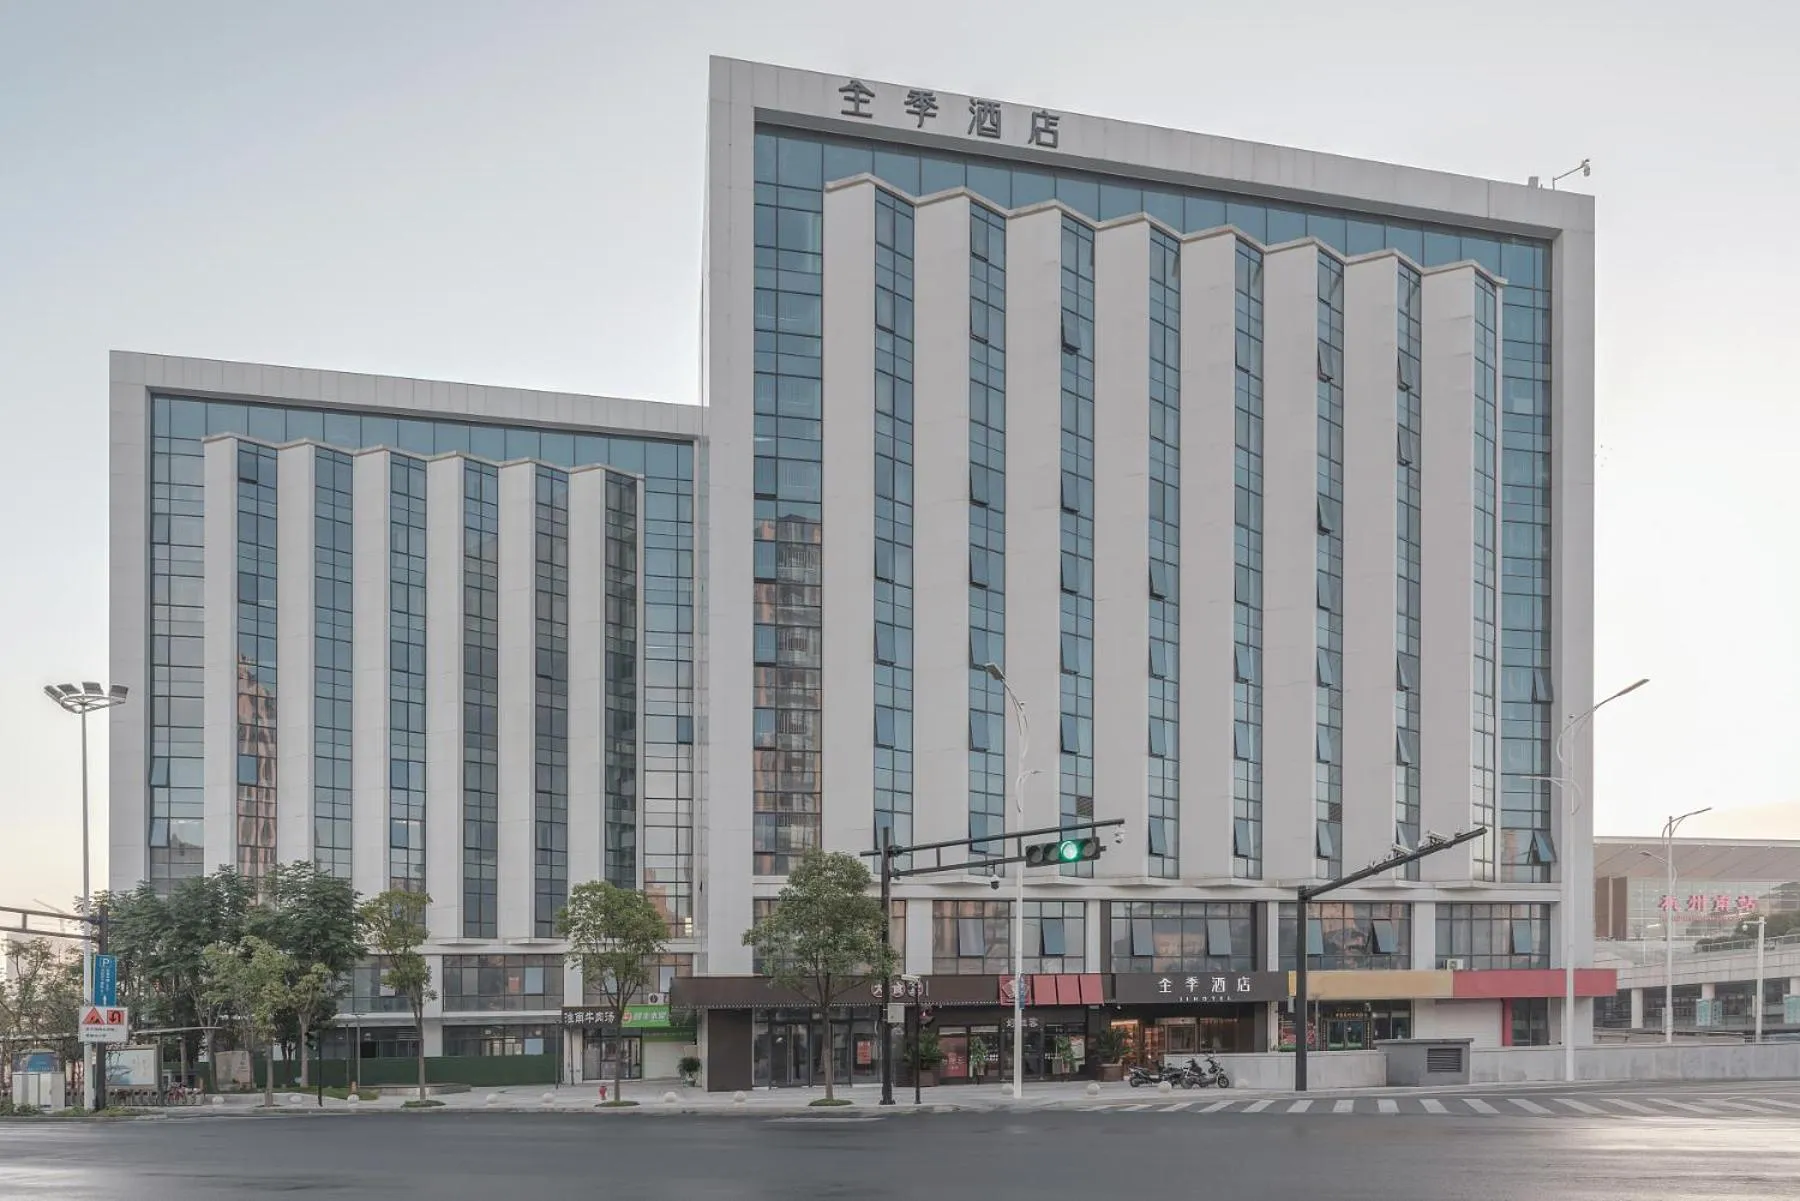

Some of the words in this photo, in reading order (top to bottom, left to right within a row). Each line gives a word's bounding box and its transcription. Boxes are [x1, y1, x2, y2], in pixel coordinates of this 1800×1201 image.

[838, 79, 1061, 149] 全季酒店
[1158, 976, 1251, 992] 全季酒店
